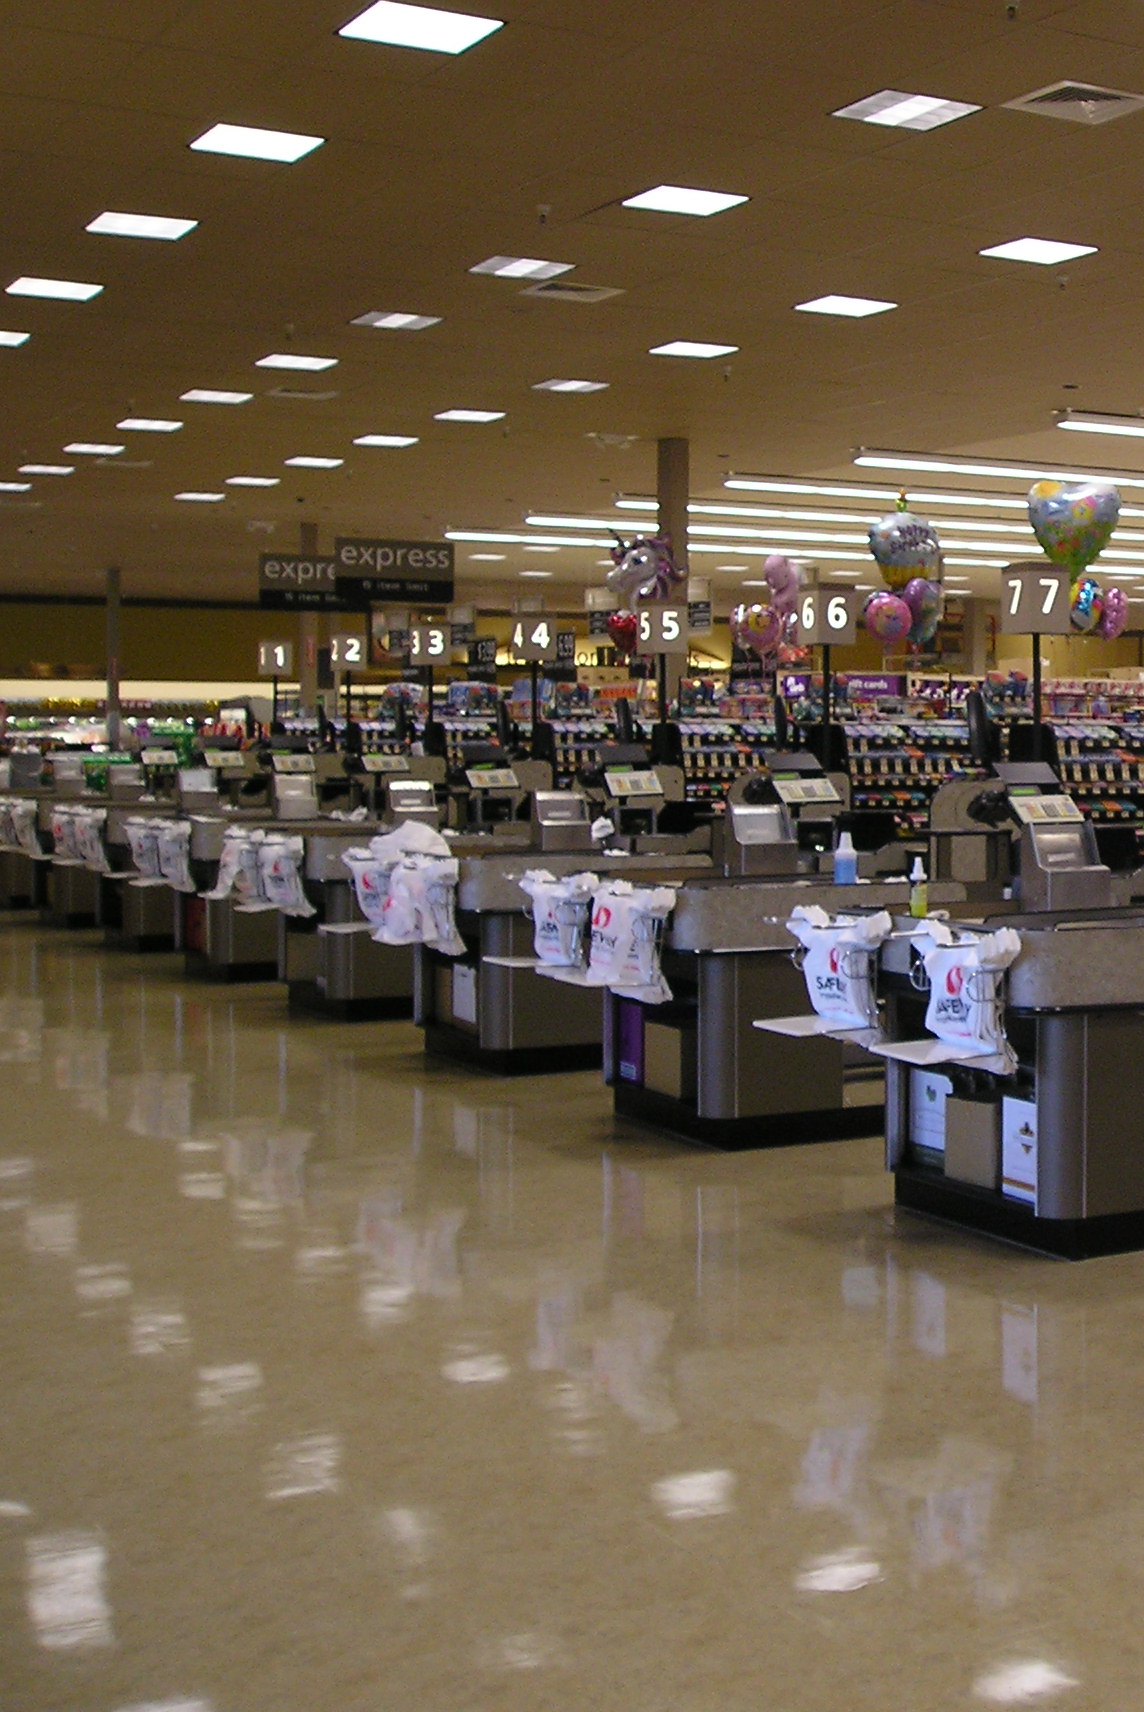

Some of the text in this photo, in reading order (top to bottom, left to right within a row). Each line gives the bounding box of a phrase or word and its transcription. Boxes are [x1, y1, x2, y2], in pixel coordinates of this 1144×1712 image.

[341, 545, 450, 572] express
[1008, 579, 1022, 615] 7
[1039, 578, 1059, 615] 7
[639, 611, 651, 641] 5
[662, 610, 680, 641] 5
[801, 597, 815, 629] 6
[827, 596, 848, 630] 6
[412, 630, 420, 655] 3
[428, 630, 445, 655] 3
[513, 622, 523, 648] 4
[531, 622, 550, 649] 4
[260, 646, 265, 666] 1
[274, 645, 285, 668] 1
[345, 638, 361, 661] 2
